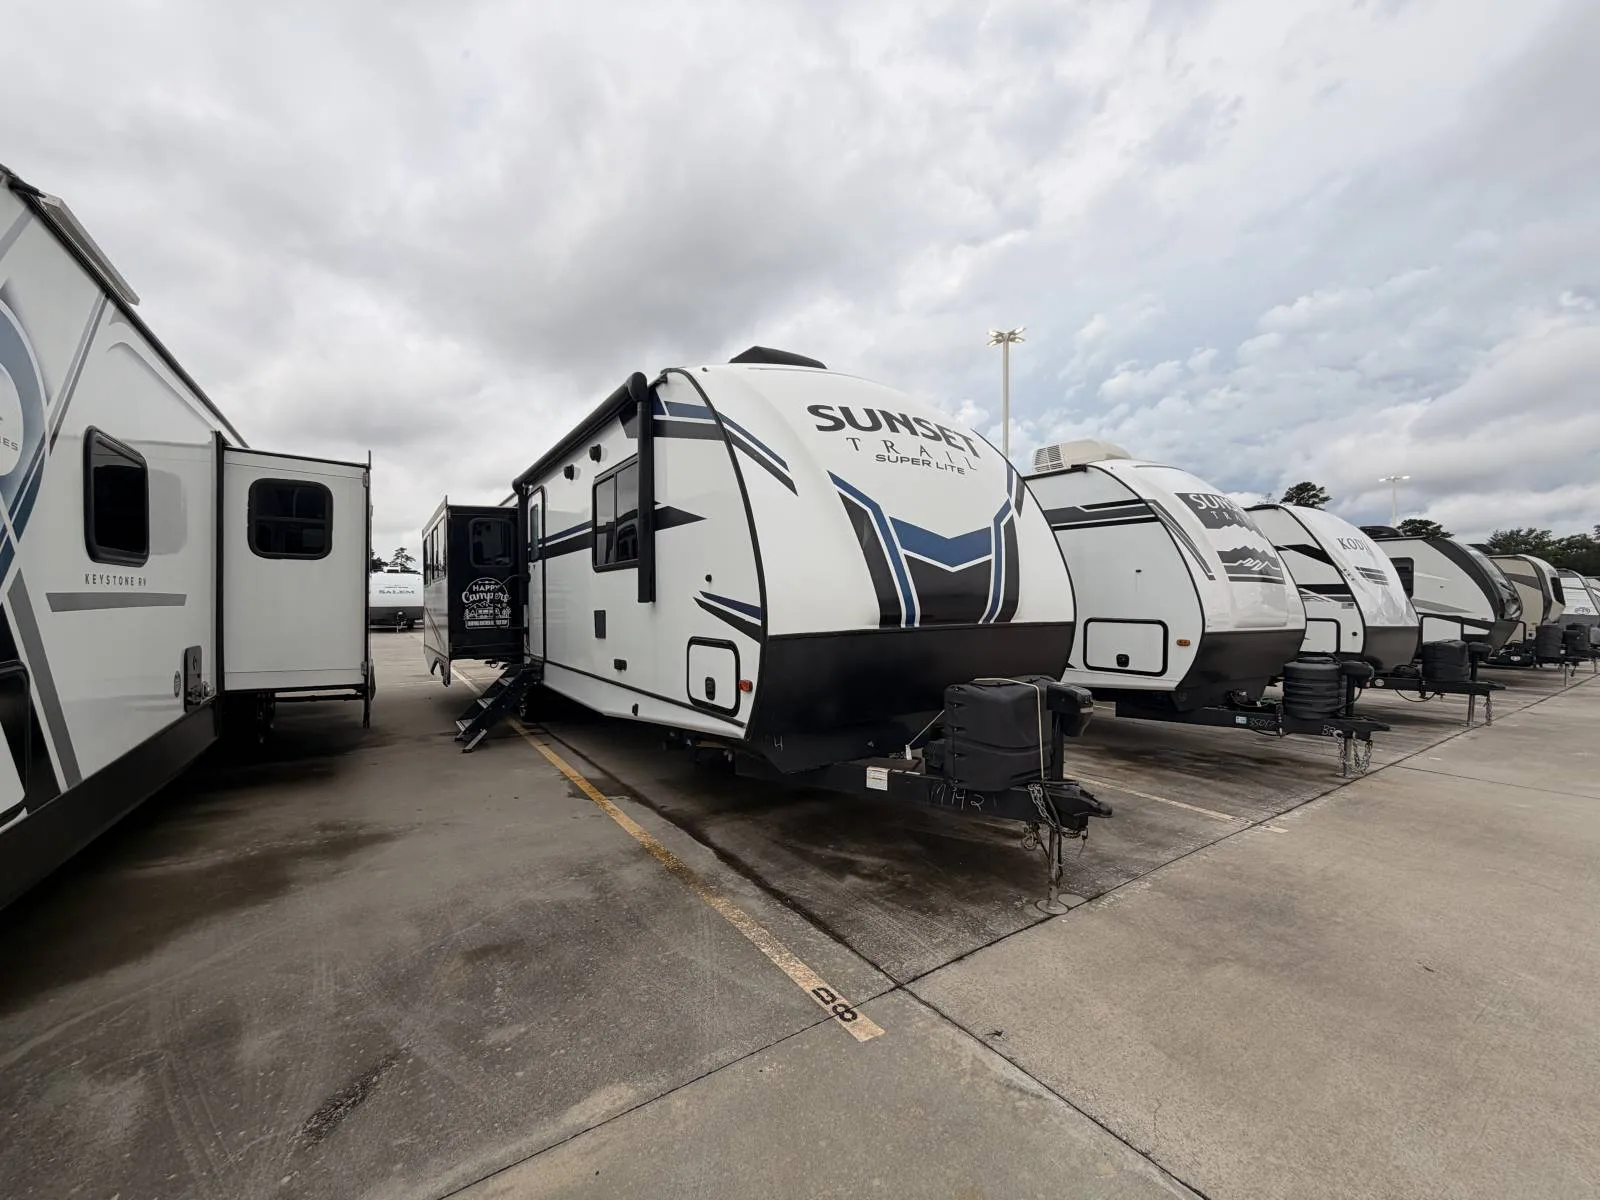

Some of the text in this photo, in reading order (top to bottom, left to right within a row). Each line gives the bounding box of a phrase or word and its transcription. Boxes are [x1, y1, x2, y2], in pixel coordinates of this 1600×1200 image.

[807, 404, 981, 459] SUNSET
[846, 437, 977, 471] TRAIL
[875, 454, 965, 475] SUPER LITE
[84, 573, 135, 586] KEYSTONE
